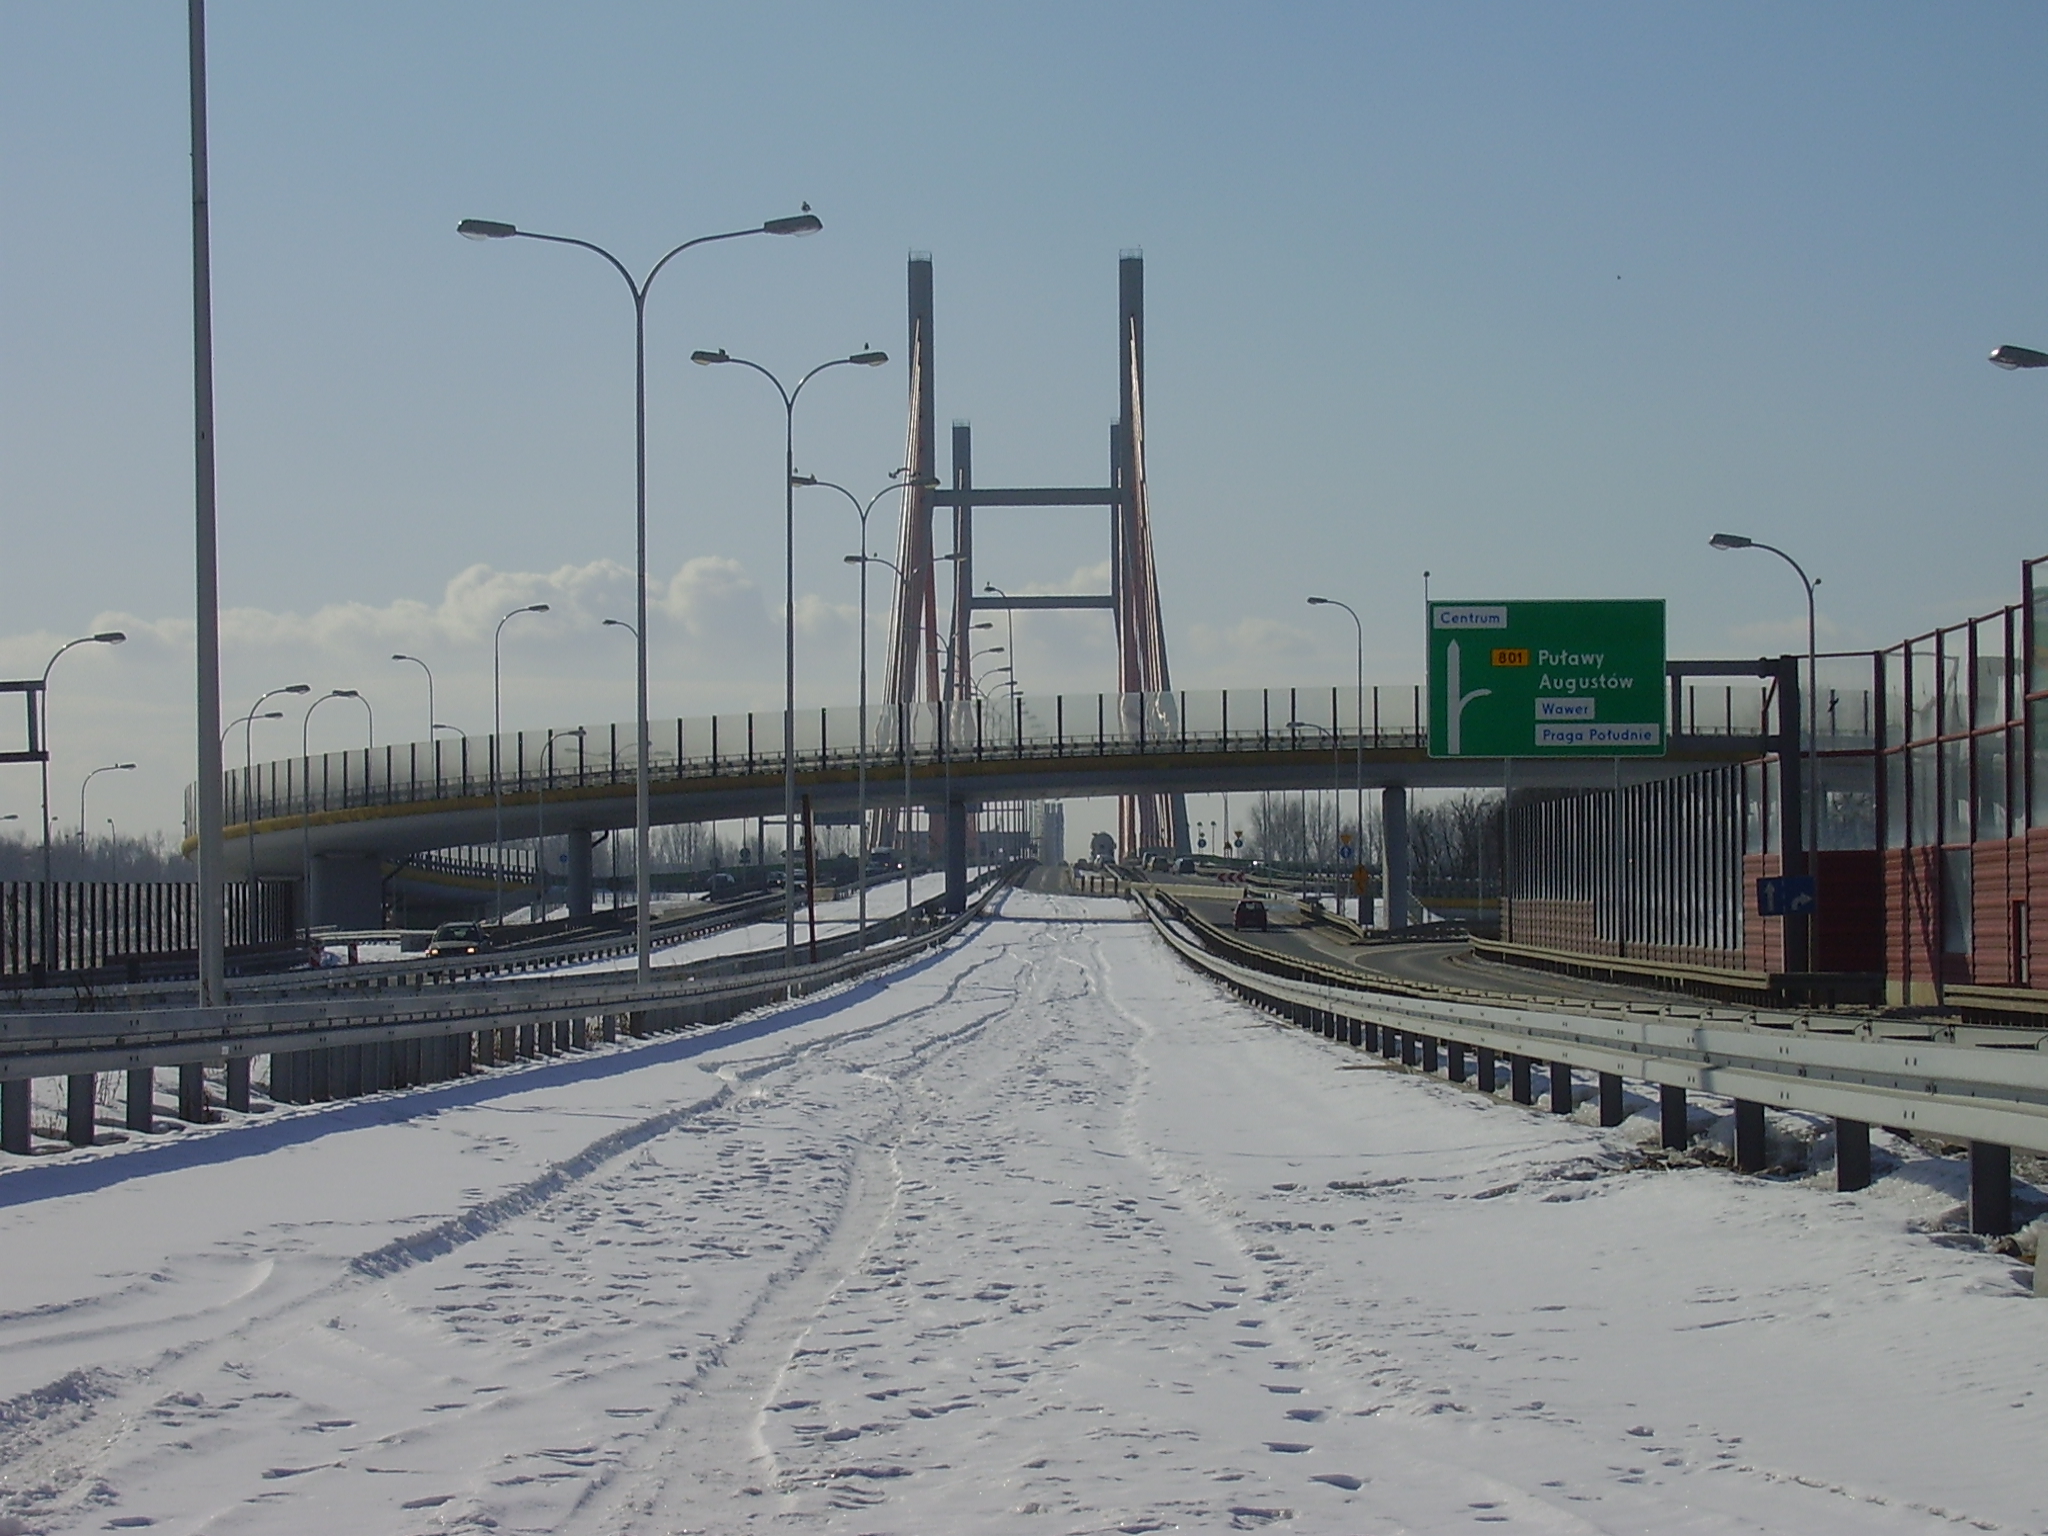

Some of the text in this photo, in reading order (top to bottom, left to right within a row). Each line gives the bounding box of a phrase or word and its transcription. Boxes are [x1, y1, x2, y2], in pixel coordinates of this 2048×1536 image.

[1440, 611, 1501, 625] Centrum
[1498, 651, 1523, 664] 801
[1538, 649, 1605, 669] Puławy
[1538, 673, 1635, 694] Augustów
[1542, 702, 1589, 716] Wawer
[1543, 728, 1653, 744] Praga Południe
